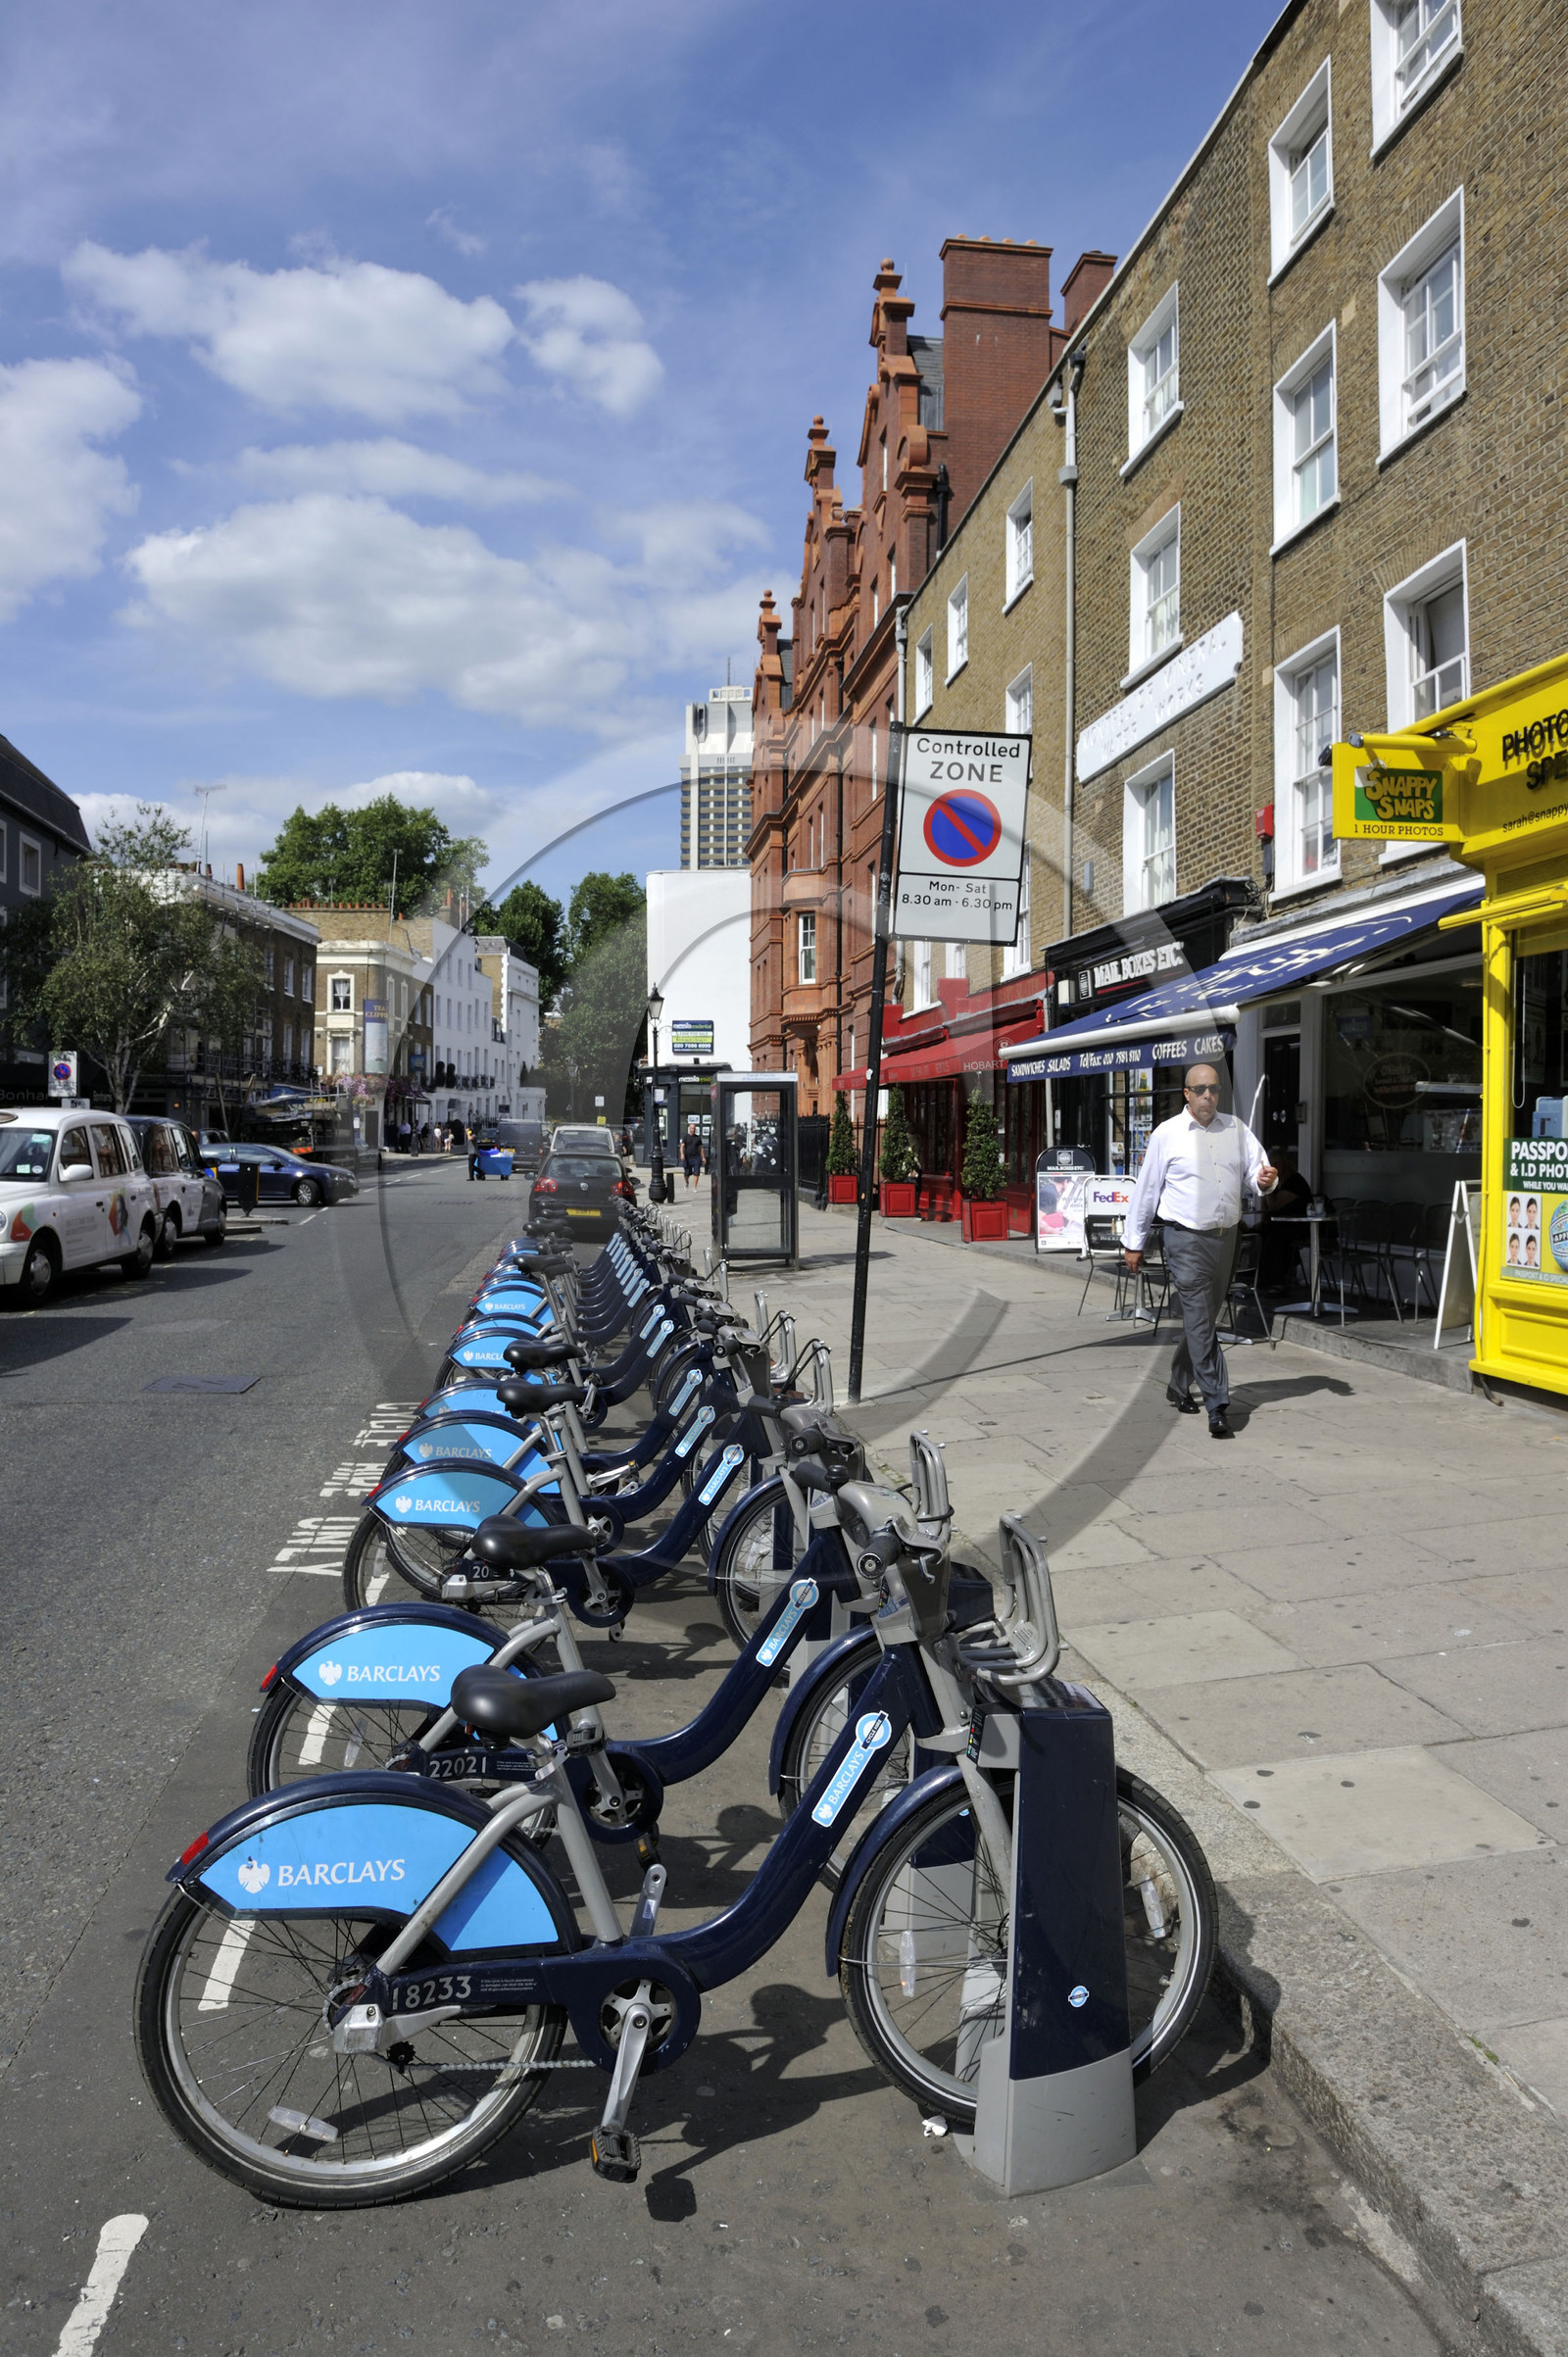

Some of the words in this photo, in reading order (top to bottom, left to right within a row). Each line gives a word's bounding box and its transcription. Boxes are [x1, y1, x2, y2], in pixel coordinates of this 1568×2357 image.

[916, 737, 1020, 759] Controlled
[929, 761, 1004, 783] ZONE
[1364, 769, 1439, 801] SNAPPY
[1375, 795, 1435, 821] SNAPS
[1353, 823, 1359, 833] 1
[1362, 824, 1395, 835] HOUR
[1397, 826, 1444, 836] PHOTOS
[965, 883, 988, 894] Sat
[902, 894, 931, 905] 8.30
[934, 898, 952, 907] am
[961, 898, 992, 909] 6.30
[994, 902, 1012, 912] pm
[1094, 960, 1122, 989] MAIL
[1121, 949, 1156, 980] BOXES
[963, 1059, 1004, 1071] HOBART
[1011, 1059, 1046, 1077] SANDWICHES
[1047, 1056, 1071, 1073] SALADS
[1152, 1040, 1188, 1060] COFFEES
[1194, 1034, 1225, 1056] CAKES
[1510, 1162, 1518, 1176] &
[1521, 1162, 1537, 1177] I.D
[1523, 1180, 1542, 1190] WHILE
[1543, 1181, 1556, 1191] YOU
[1093, 1191, 1129, 1203] FedEx
[435, 1446, 492, 1459] BARCLAYS
[707, 1463, 729, 1494] BARCLAYS
[415, 1499, 481, 1513] BARCLAYS
[769, 1608, 798, 1650] BARCLAYS
[347, 1665, 441, 1683] BARCLAYS
[429, 1755, 487, 1778] 22021
[828, 1749, 864, 1806] BARCLAYS
[277, 1859, 406, 1888] BARCLAYS
[392, 1975, 472, 2011] 18233
